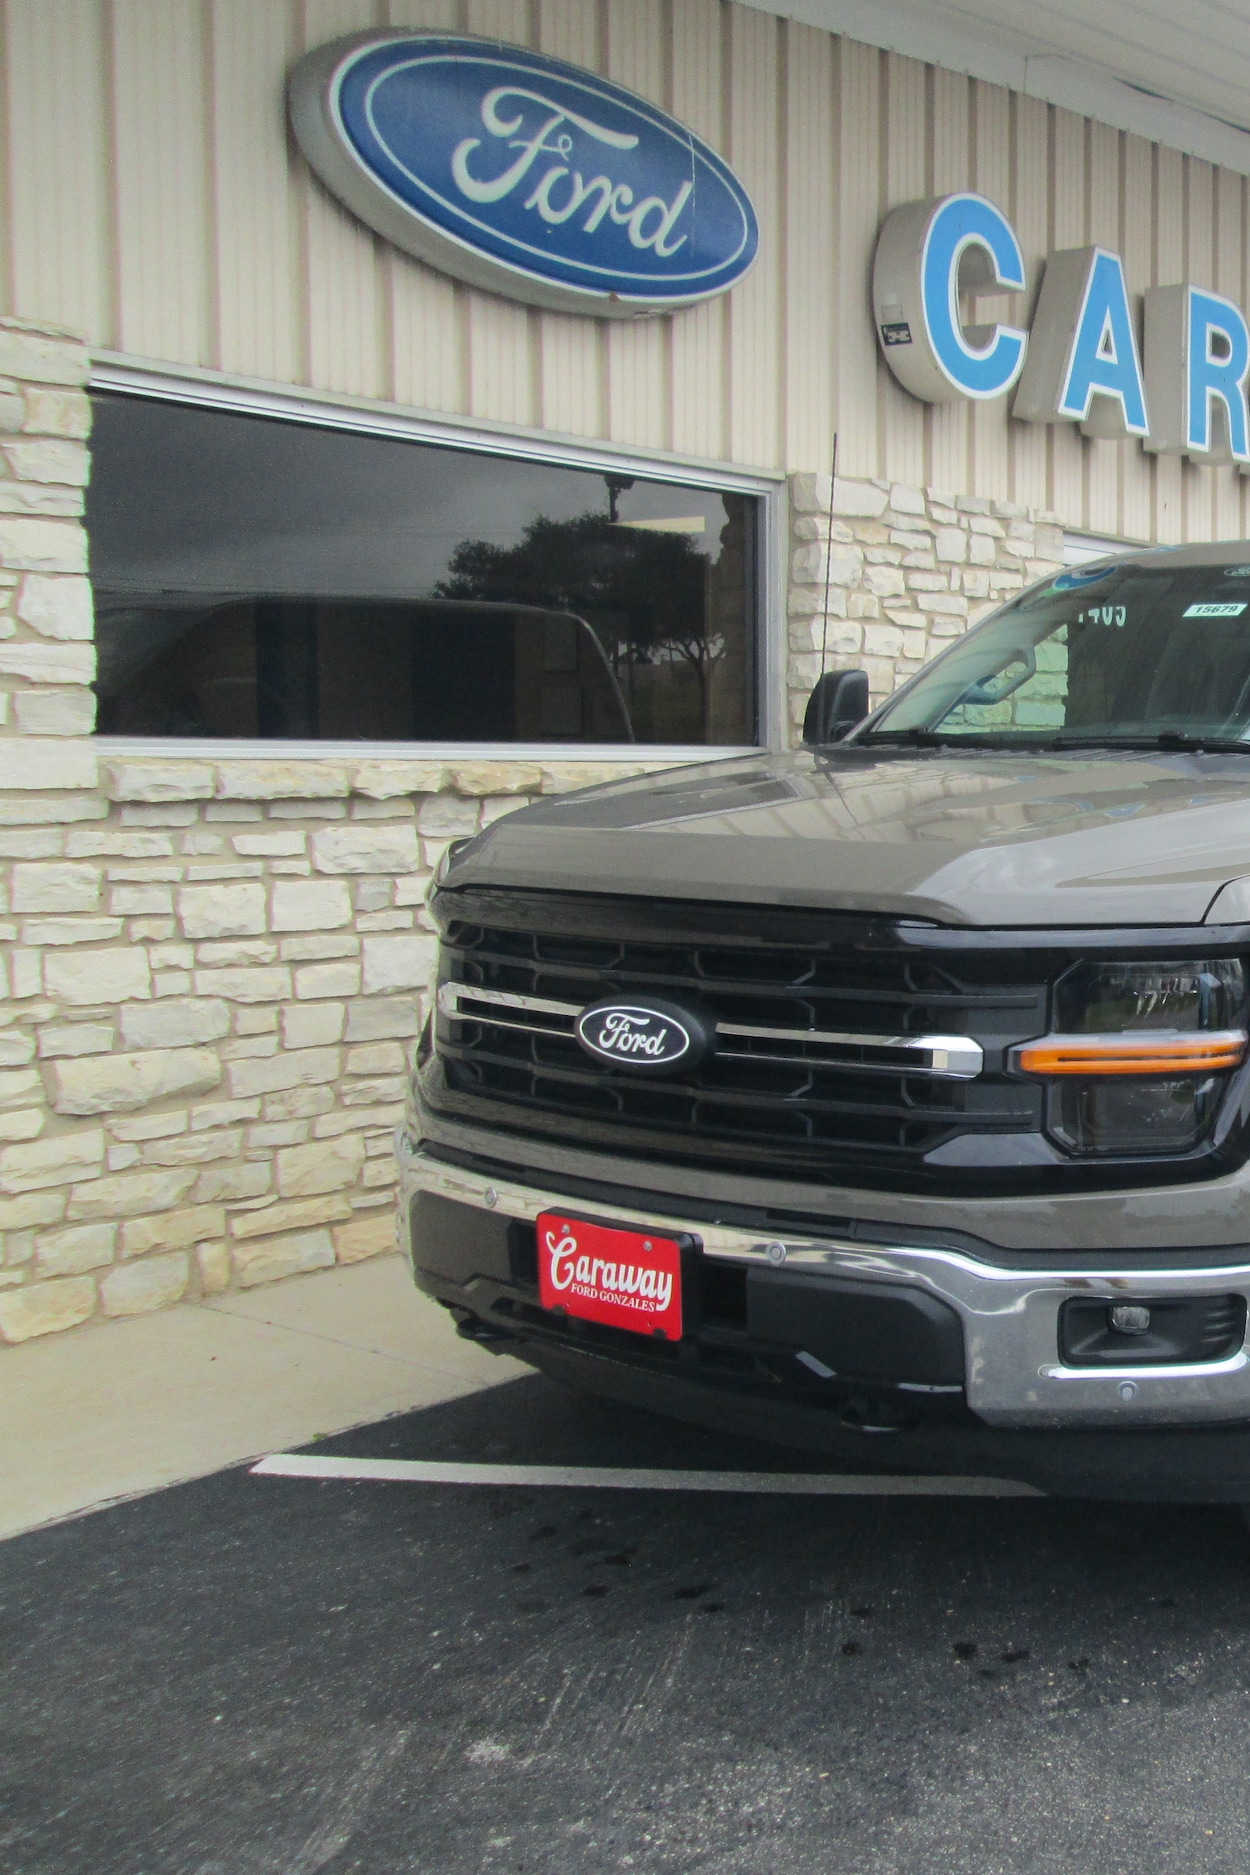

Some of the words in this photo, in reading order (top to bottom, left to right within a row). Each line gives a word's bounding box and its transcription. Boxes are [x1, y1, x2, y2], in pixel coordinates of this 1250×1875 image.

[451, 86, 694, 257] Ford
[1194, 605, 1239, 614] 15679
[599, 1012, 667, 1056] Ford
[546, 1231, 673, 1312] Caraway
[570, 1282, 598, 1299] FORD
[600, 1290, 656, 1313] GONZALES
